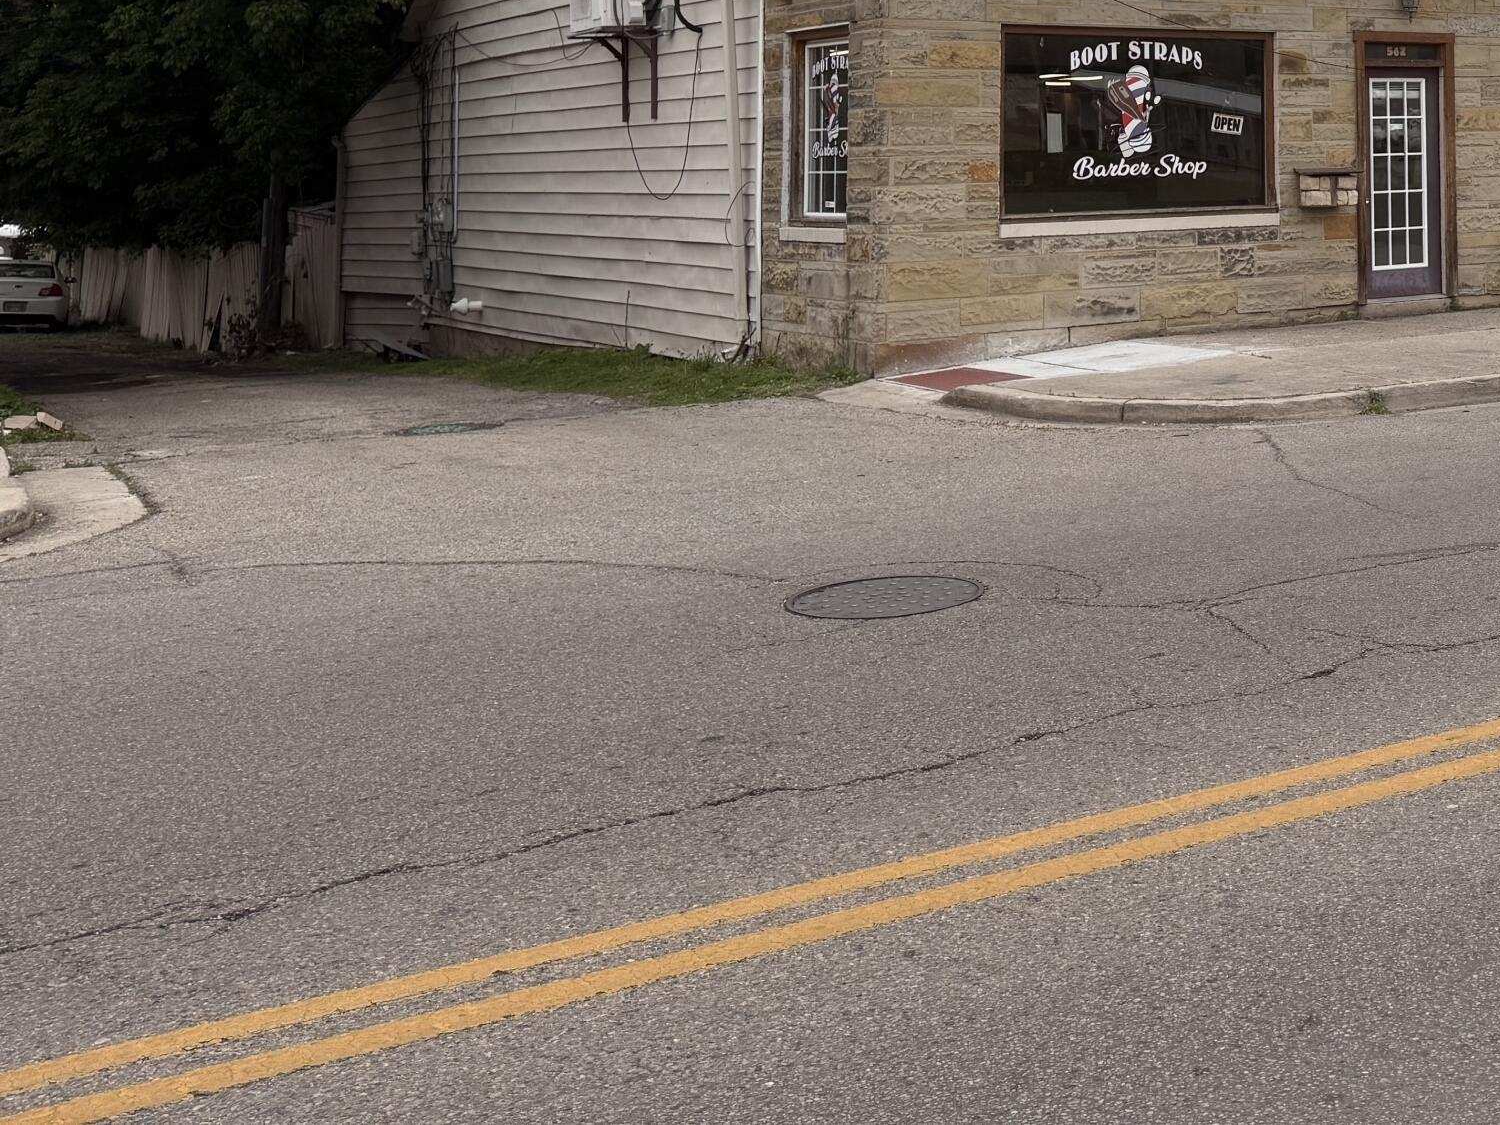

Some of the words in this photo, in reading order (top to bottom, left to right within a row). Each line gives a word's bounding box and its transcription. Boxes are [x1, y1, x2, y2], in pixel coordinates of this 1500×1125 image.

[1070, 41, 1120, 70] BOOT
[1128, 41, 1203, 70] STRAPS
[1214, 116, 1241, 132] OPEN
[1072, 156, 1151, 180] Barber
[1154, 154, 1207, 180] Shop
